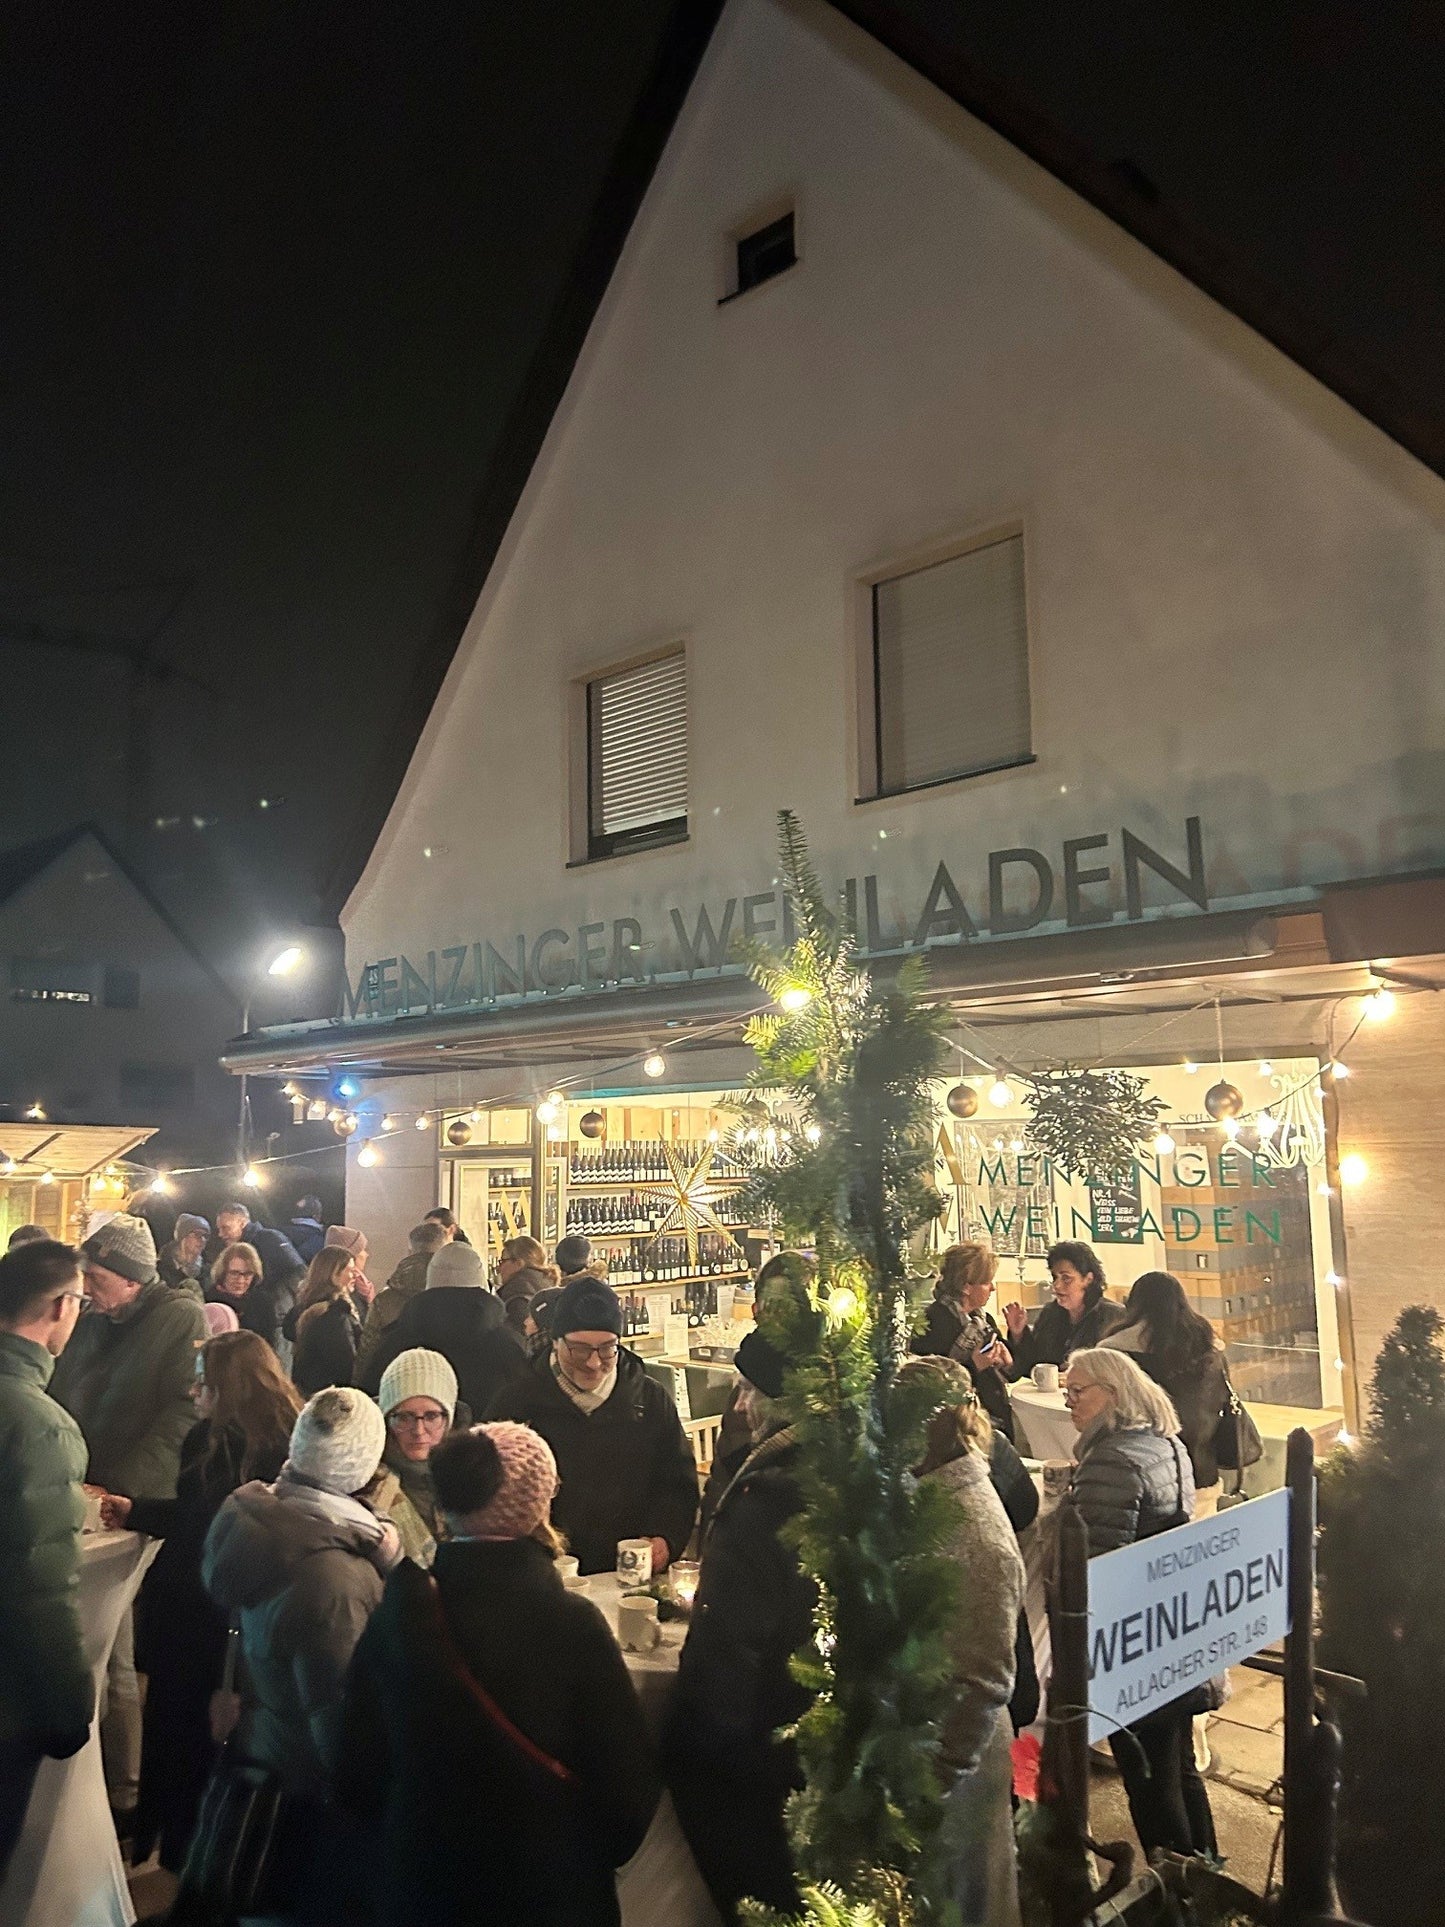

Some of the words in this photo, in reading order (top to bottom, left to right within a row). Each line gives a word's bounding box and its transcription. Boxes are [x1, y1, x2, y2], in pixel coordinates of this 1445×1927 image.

[342, 917, 647, 1021] MENZINGER
[1147, 1527, 1241, 1583] MENZINGER
[1088, 1548, 1284, 1680] WEINLADEN
[1116, 1649, 1205, 1714] ALLACHER
[1209, 1632, 1242, 1665] STR.
